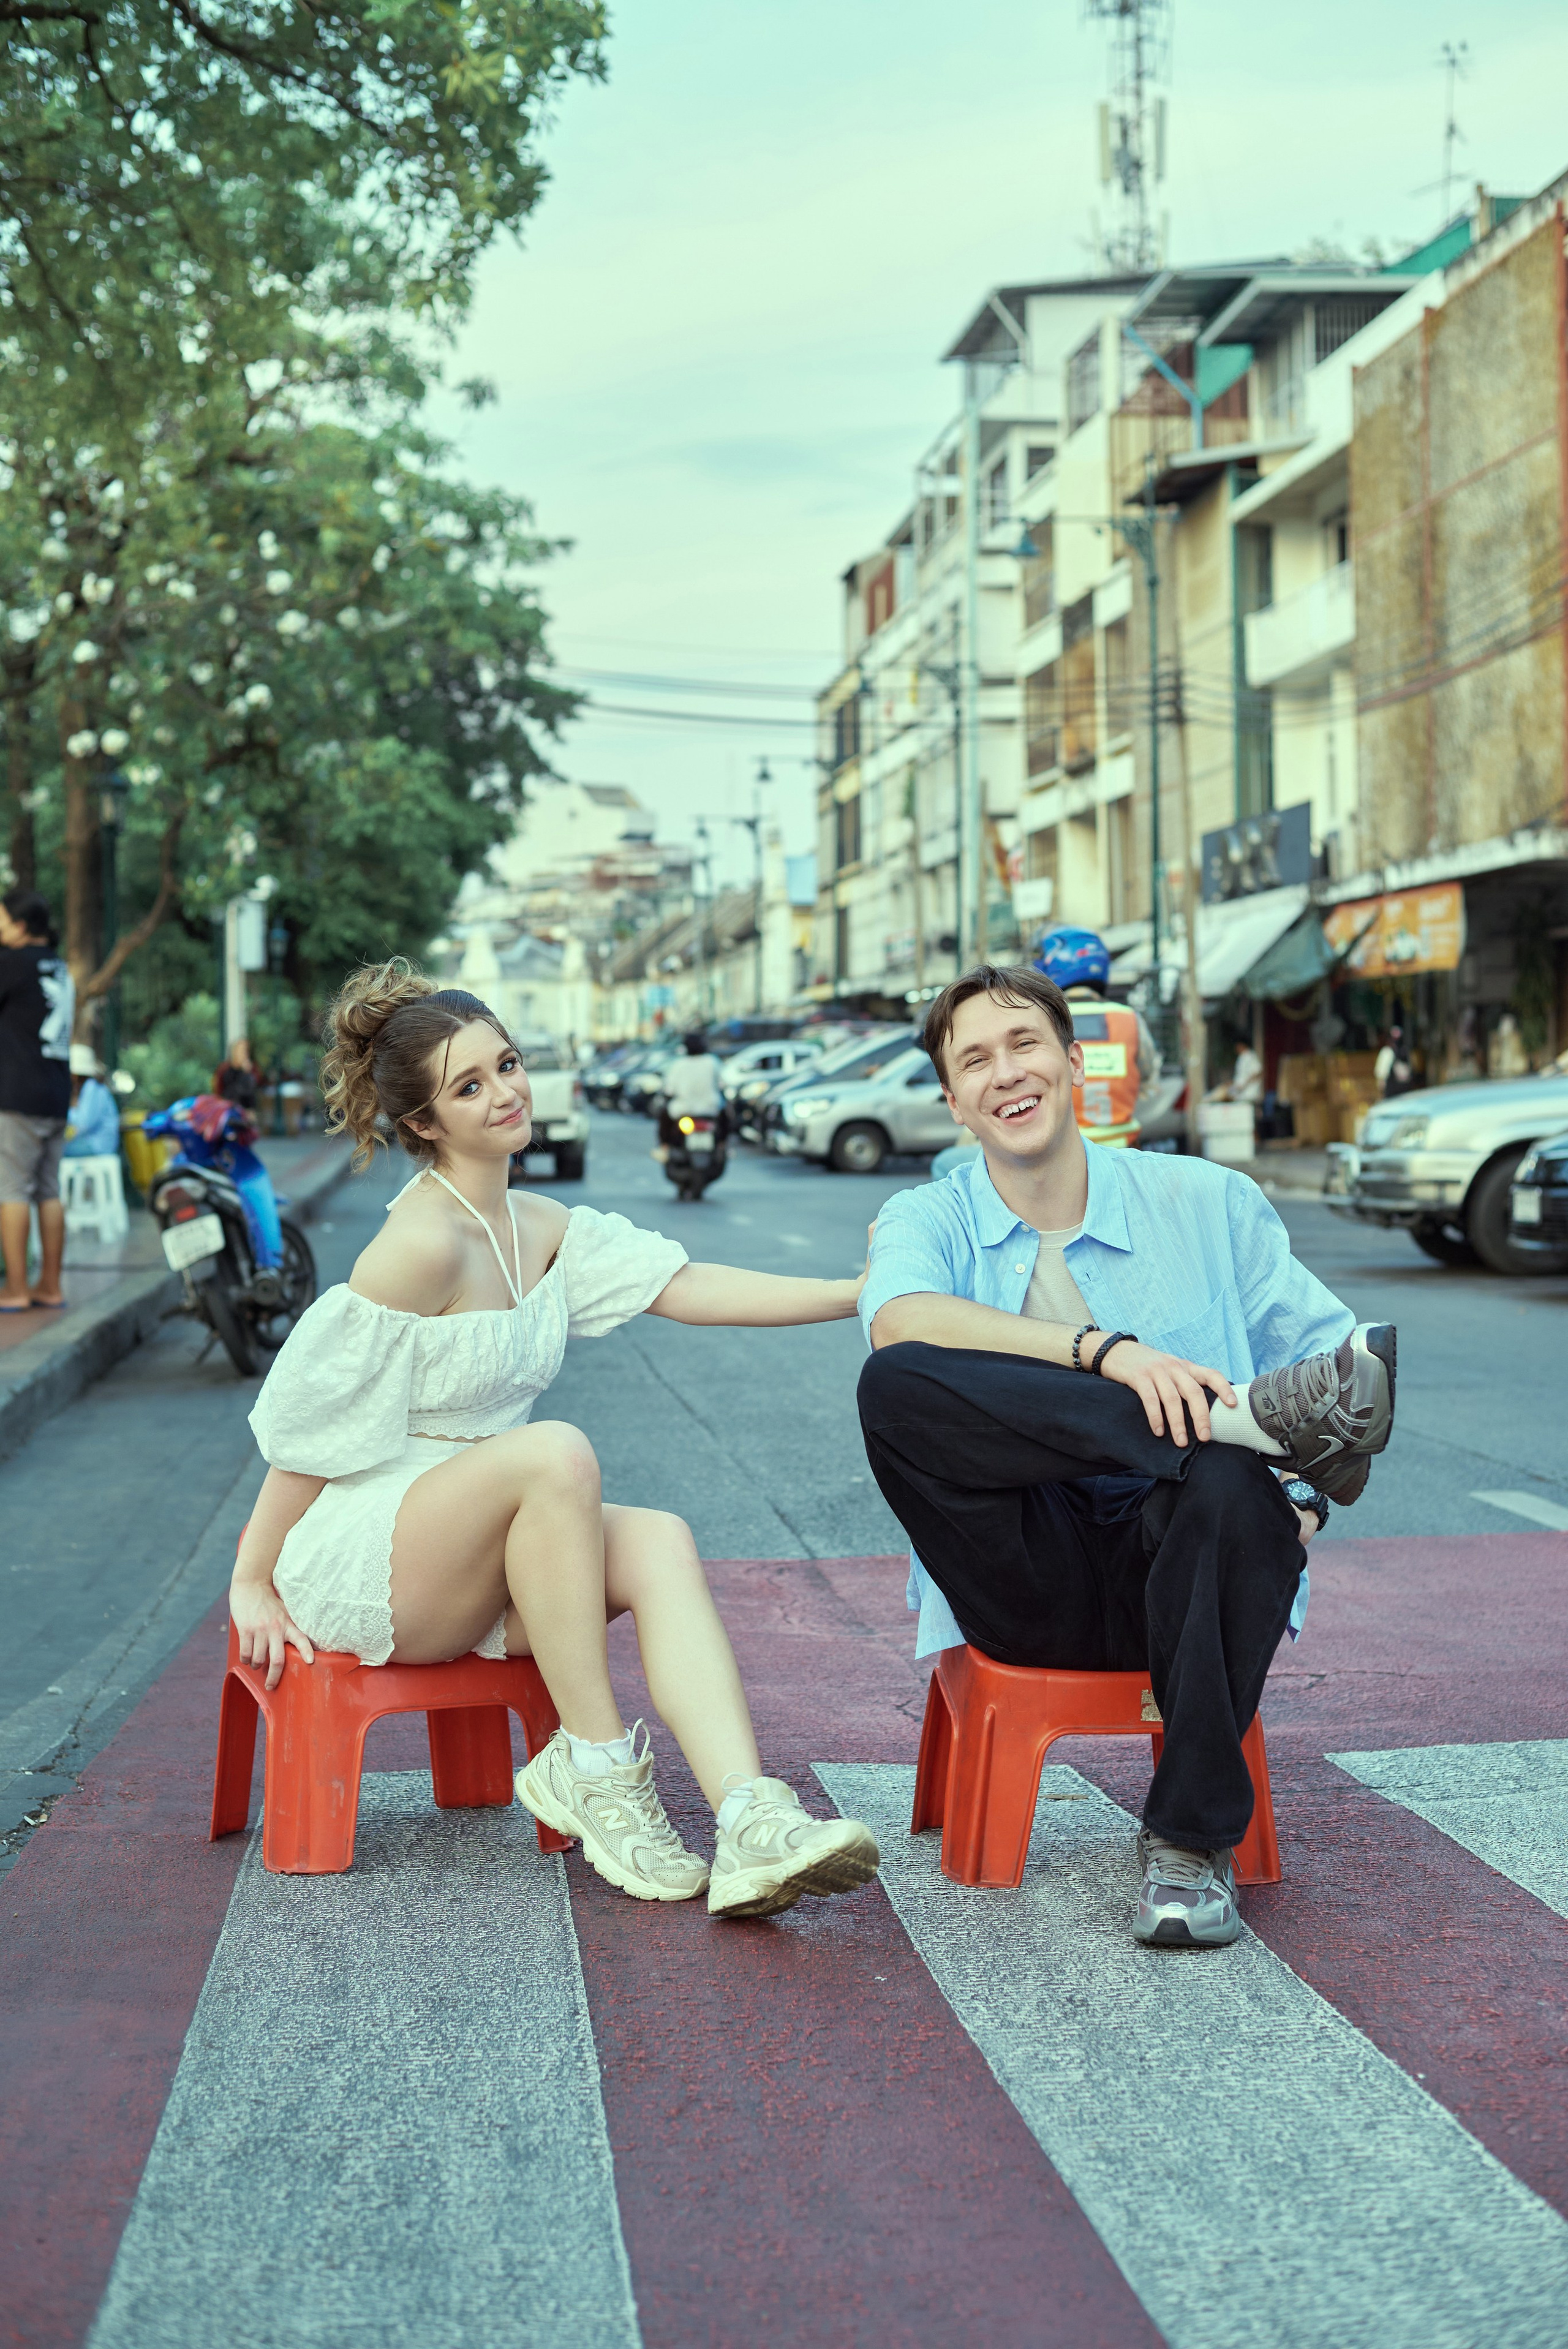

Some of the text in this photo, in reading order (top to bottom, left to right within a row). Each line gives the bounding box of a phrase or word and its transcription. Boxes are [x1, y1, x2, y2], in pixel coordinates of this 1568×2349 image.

[1083, 1081, 1112, 1125] 5
[1262, 1397, 1272, 1409] NIKE
[595, 1806, 630, 1832] N
[752, 1823, 778, 1848] N
